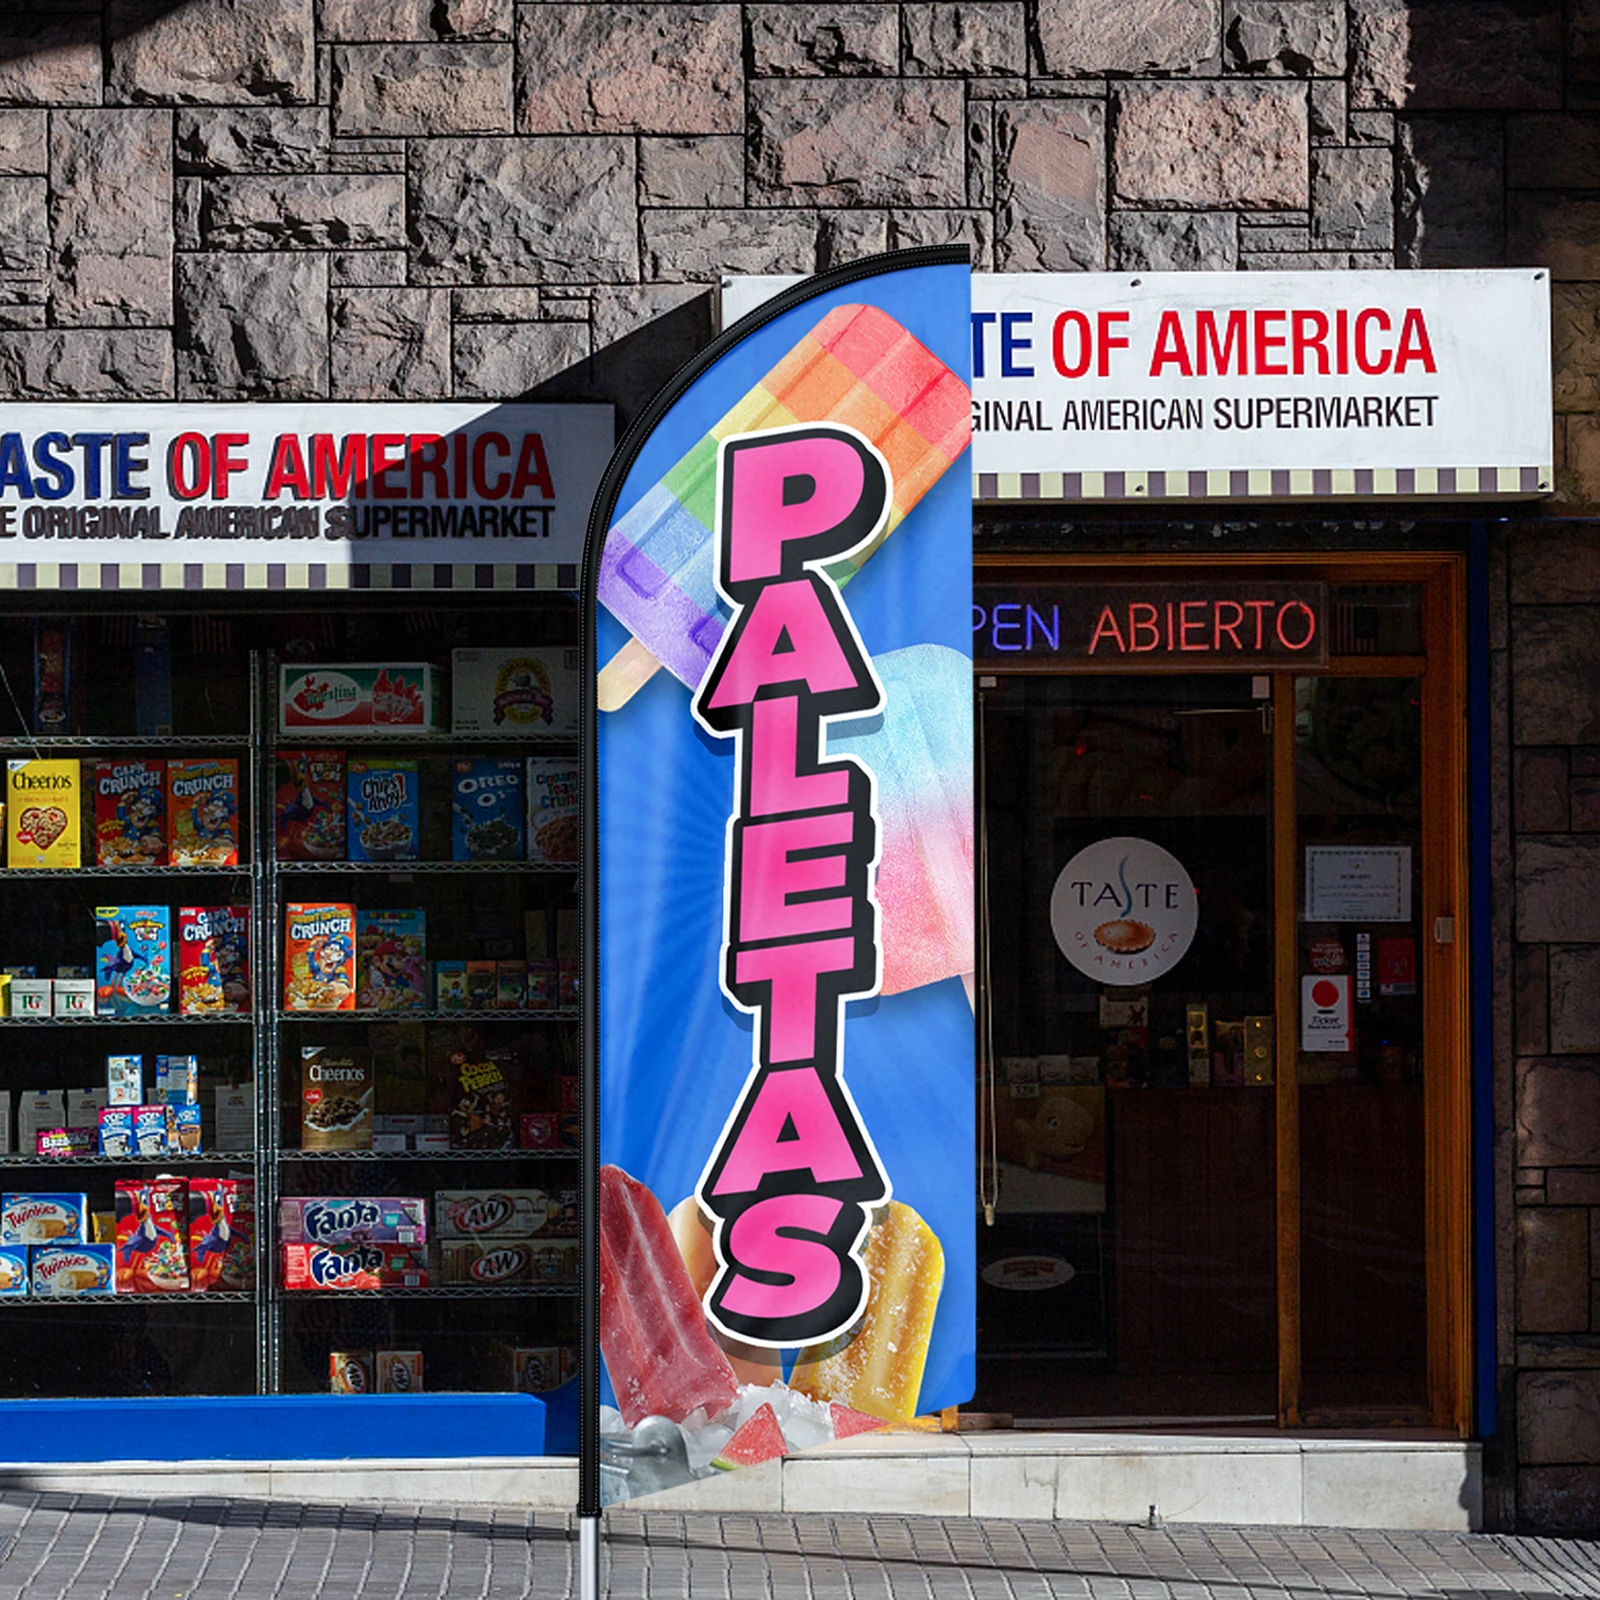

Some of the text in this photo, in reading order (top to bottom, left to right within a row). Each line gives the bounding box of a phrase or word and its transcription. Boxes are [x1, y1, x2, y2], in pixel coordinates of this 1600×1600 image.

[1052, 310, 1129, 378] OF
[1149, 307, 1438, 377] AMERICA
[1063, 399, 1202, 430] AMERICAN
[1213, 395, 1438, 429] SUPERMARKET
[0, 431, 554, 500] ASTE OF AMERICA
[23, 506, 169, 539] ORIGINAL
[173, 506, 319, 539] AMERICAN
[324, 506, 554, 540] SUPERMARKET
[1089, 601, 1315, 654] ABIERTO
[13, 772, 72, 790] Cheerios
[100, 771, 162, 795] CRUNCH
[173, 774, 234, 796] CRUNCH
[458, 774, 519, 794] OREO
[540, 795, 578, 808] Crun
[698, 428, 886, 1340] PALETAS
[1071, 865, 1178, 916] TASTE
[183, 917, 246, 942] CRUNCH
[291, 918, 351, 941] CRUNCH
[309, 1064, 366, 1081] Cheerios
[6, 1203, 57, 1228] Twinkies
[306, 1200, 379, 1239] Fanta
[36, 1254, 88, 1279] Twinkies
[312, 1245, 383, 1284] Fanta
